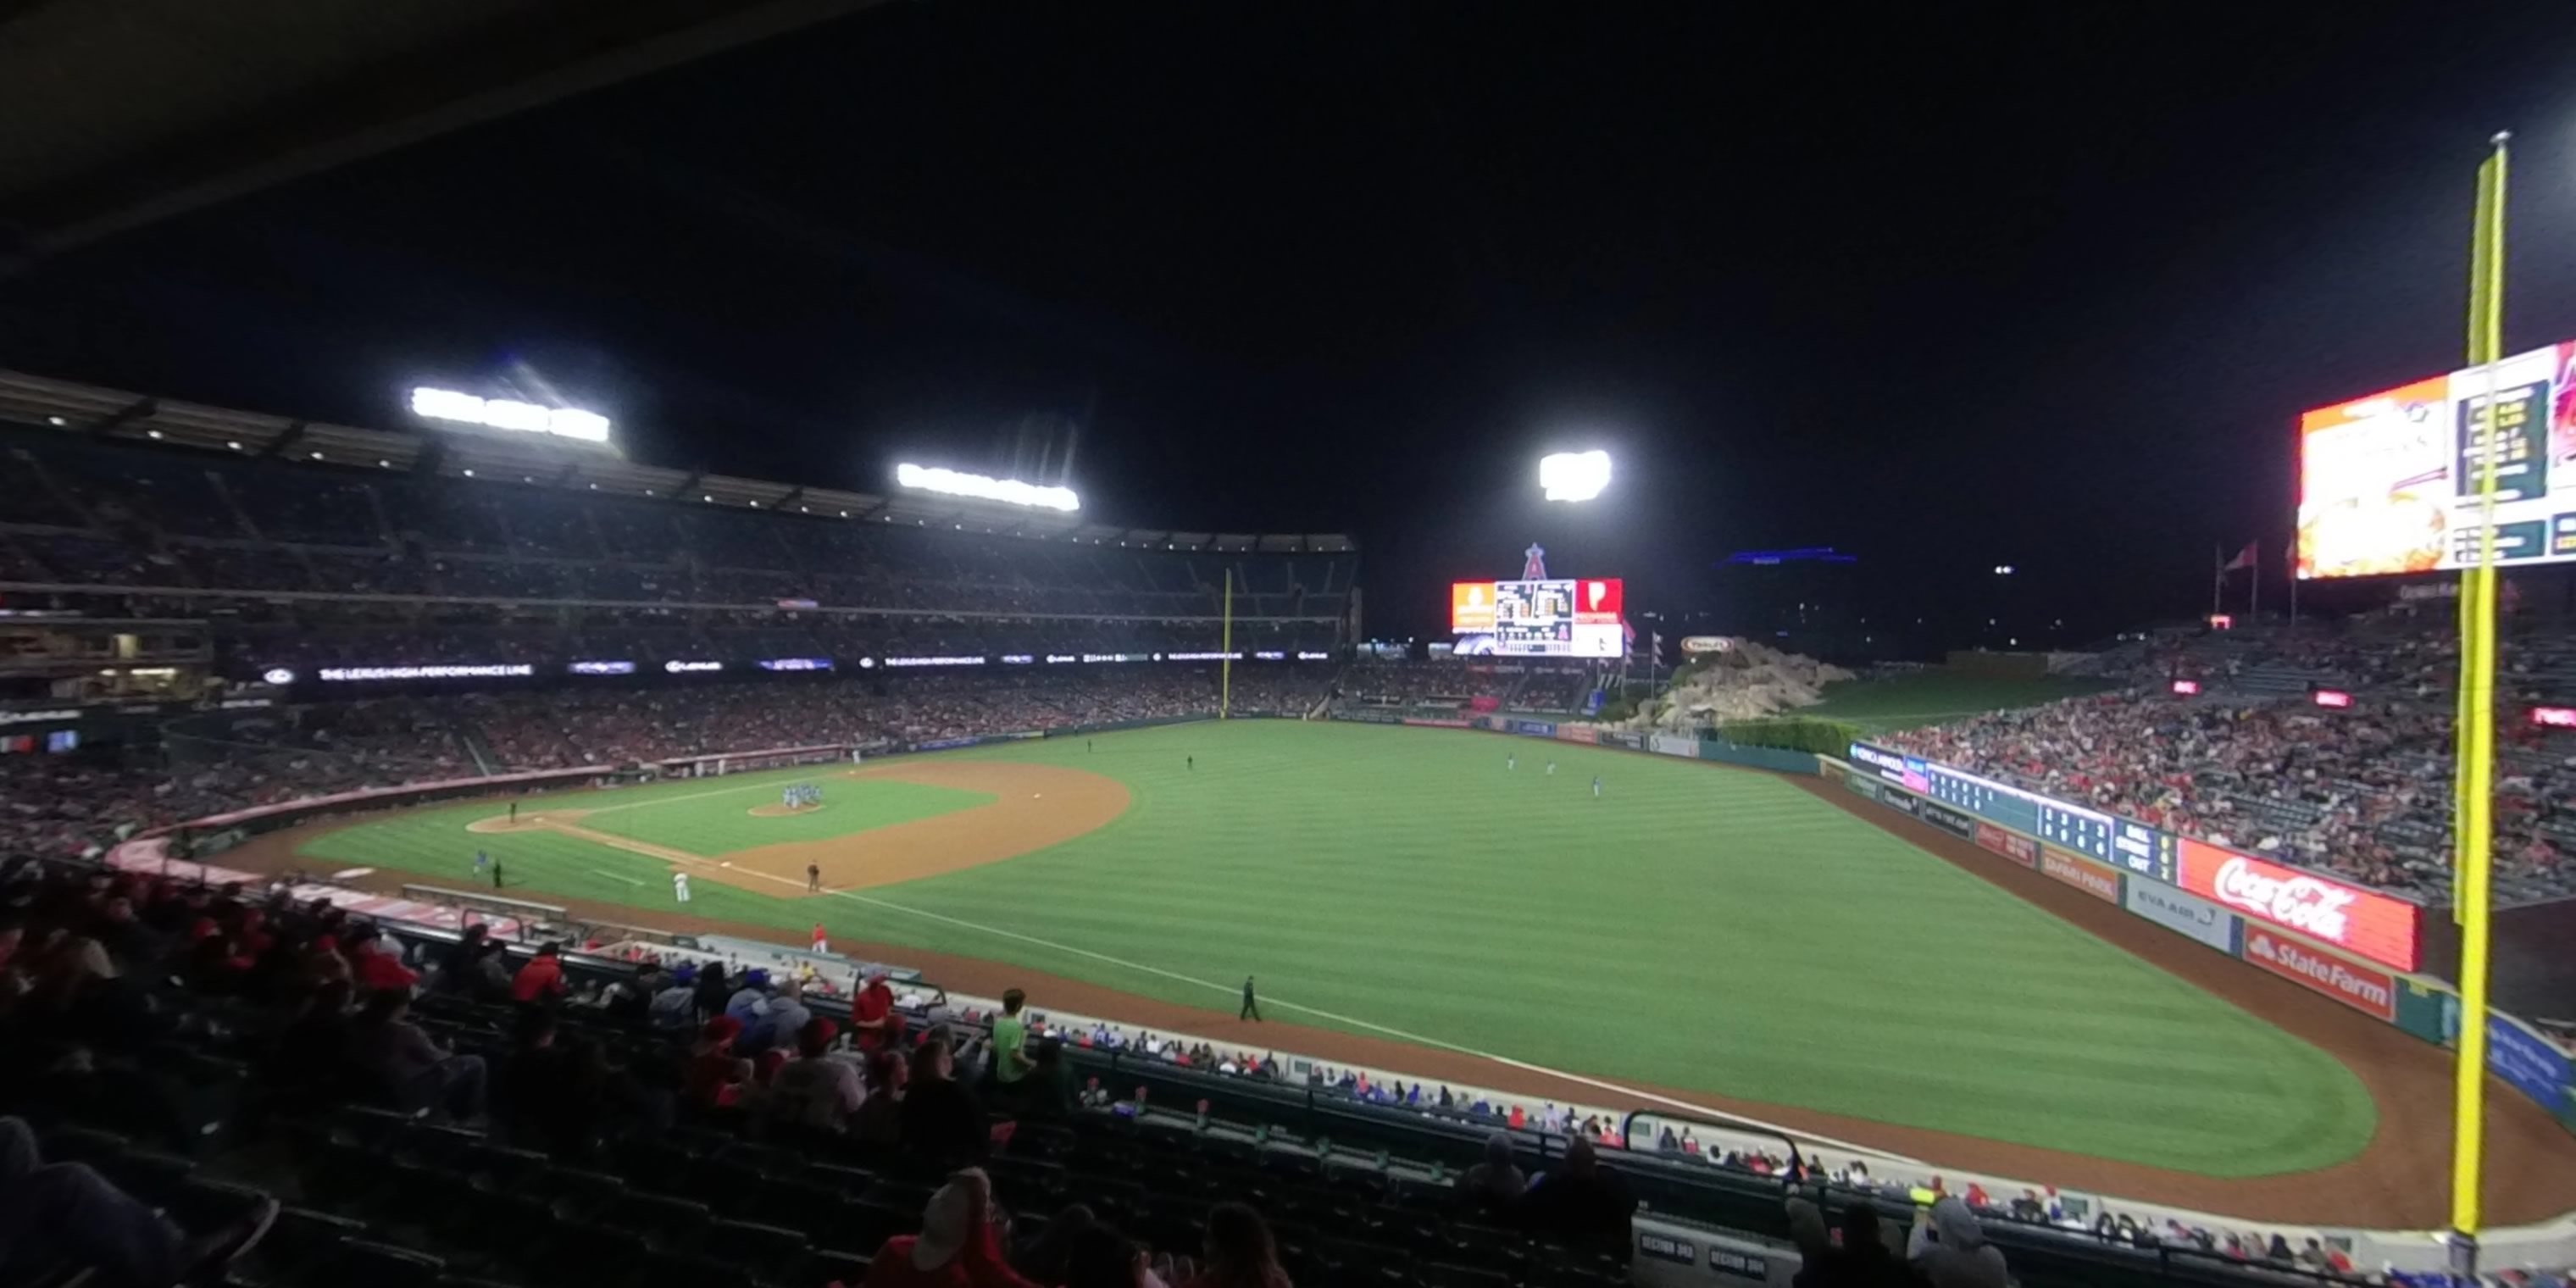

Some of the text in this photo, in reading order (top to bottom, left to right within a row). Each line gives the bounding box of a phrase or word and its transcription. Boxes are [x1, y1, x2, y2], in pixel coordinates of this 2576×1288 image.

[2128, 854, 2150, 873] OUT
[2137, 890, 2196, 921] EVA AIR
